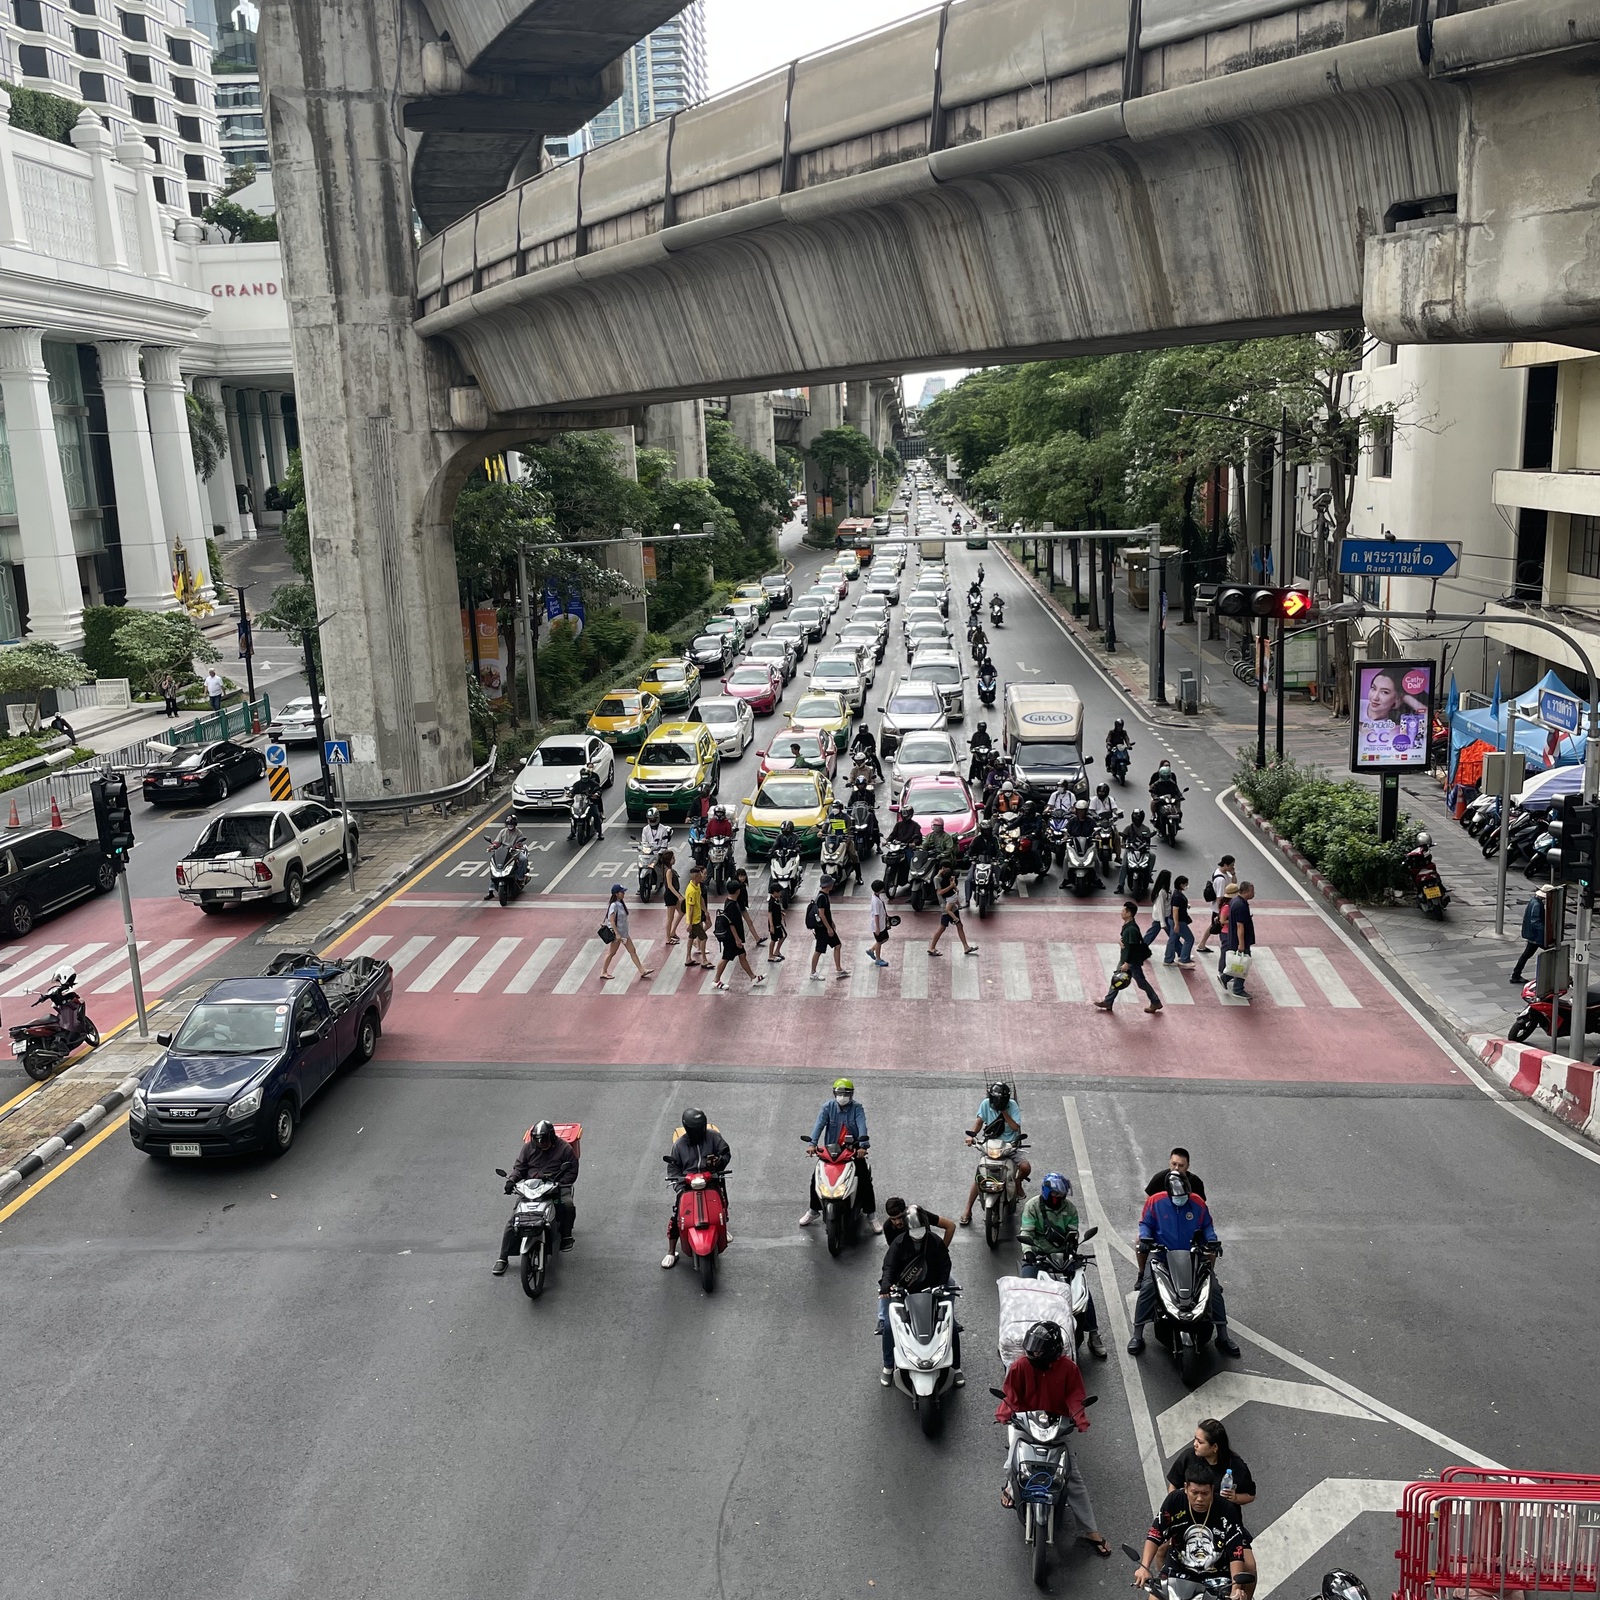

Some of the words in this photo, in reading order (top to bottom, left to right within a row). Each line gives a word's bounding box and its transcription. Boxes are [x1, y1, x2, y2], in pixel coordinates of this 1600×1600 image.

[211, 282, 278, 297] GRAND
[1351, 552, 1360, 563] ถ.
[1363, 544, 1422, 565] พระรามที่
[1366, 565, 1391, 573] Rama
[1405, 676, 1424, 684] Cathy
[1366, 732, 1390, 743] CC
[170, 1109, 197, 1117] ISUZU
